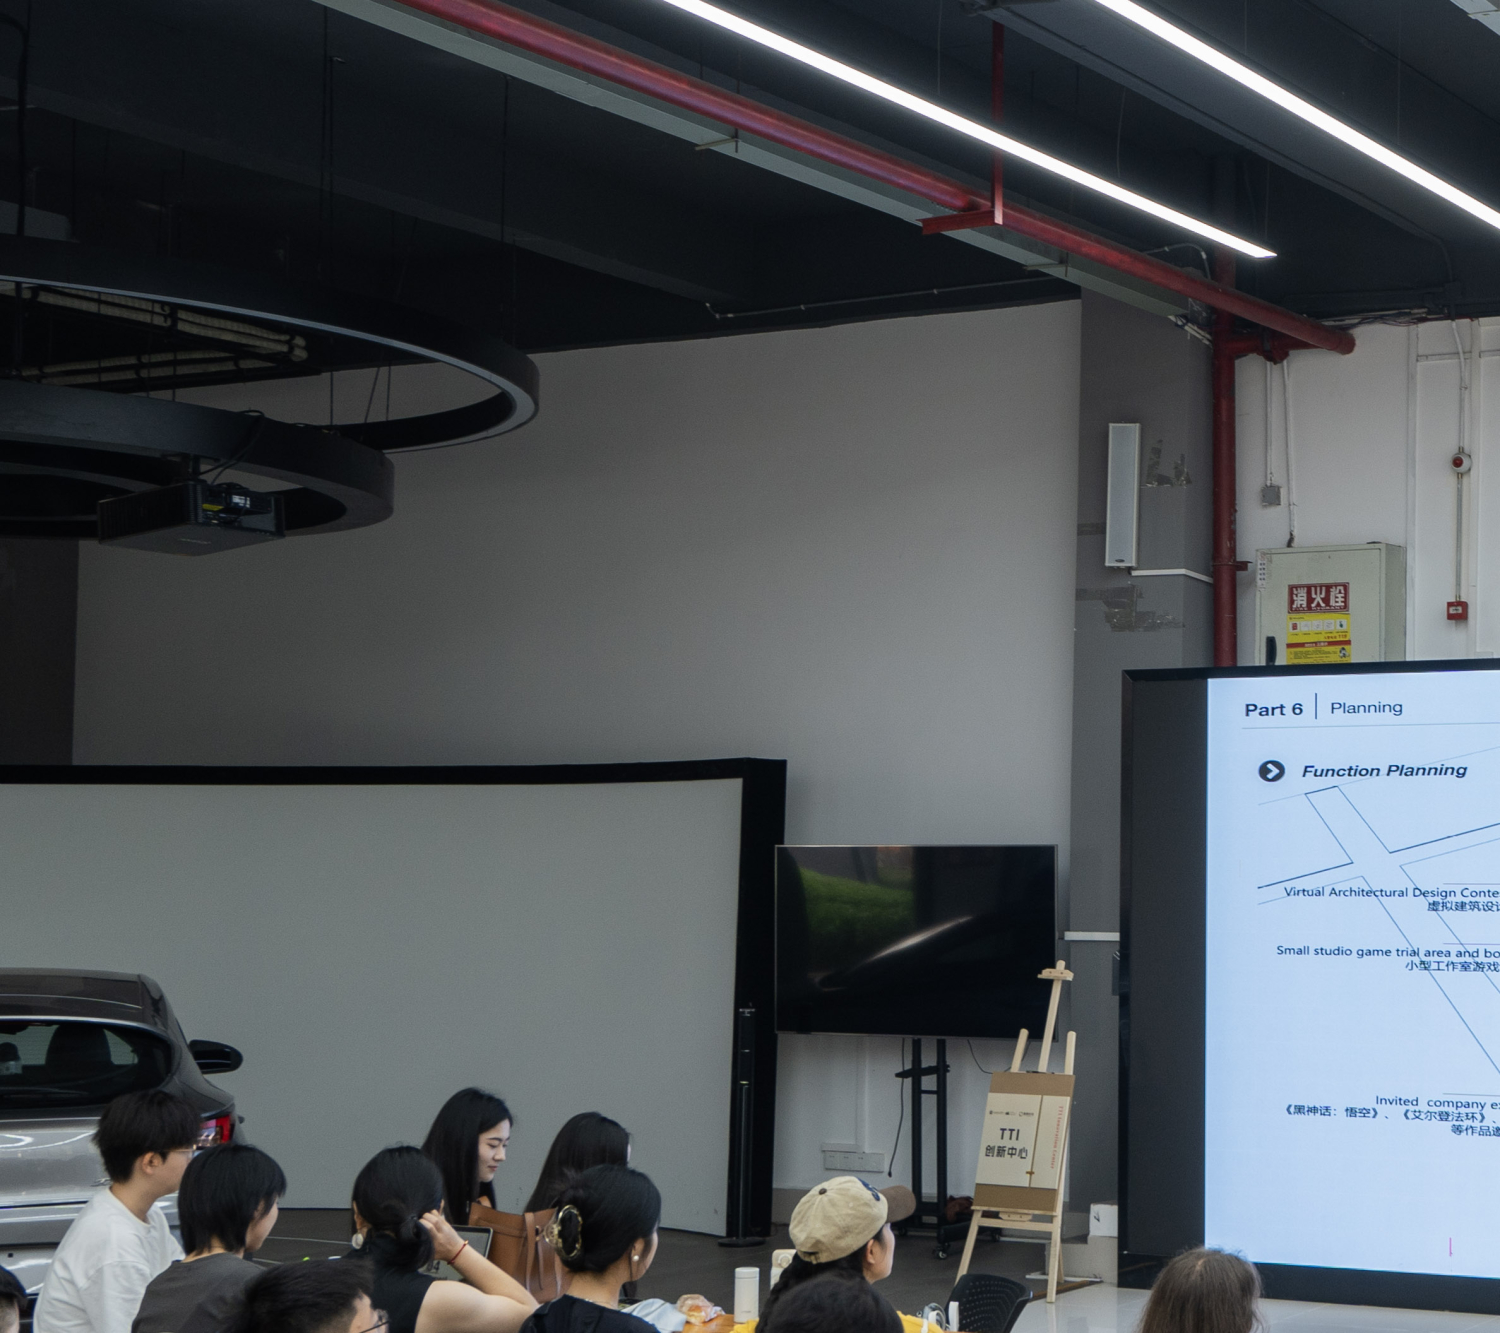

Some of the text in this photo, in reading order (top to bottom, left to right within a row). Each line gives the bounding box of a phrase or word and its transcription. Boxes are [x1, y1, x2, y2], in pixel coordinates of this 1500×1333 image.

[1291, 586, 1345, 608] 消火栓
[1245, 702, 1303, 717] Part 6
[1331, 701, 1403, 716] Planning
[1302, 763, 1468, 778] Function Planning
[1284, 886, 1325, 898] Virtual
[1329, 886, 1408, 898] Architectural
[1413, 887, 1456, 900] Design
[1276, 945, 1310, 956] Small
[1313, 945, 1353, 957] studio
[1356, 948, 1392, 959] game
[1395, 946, 1421, 957] trial
[1423, 949, 1451, 958] area
[1455, 948, 1480, 958] and
[1375, 1095, 1419, 1107] Invited
[1427, 1098, 1486, 1112] company
[1000, 1128, 1020, 1141] TTI
[985, 1144, 1028, 1159] 创新中心
